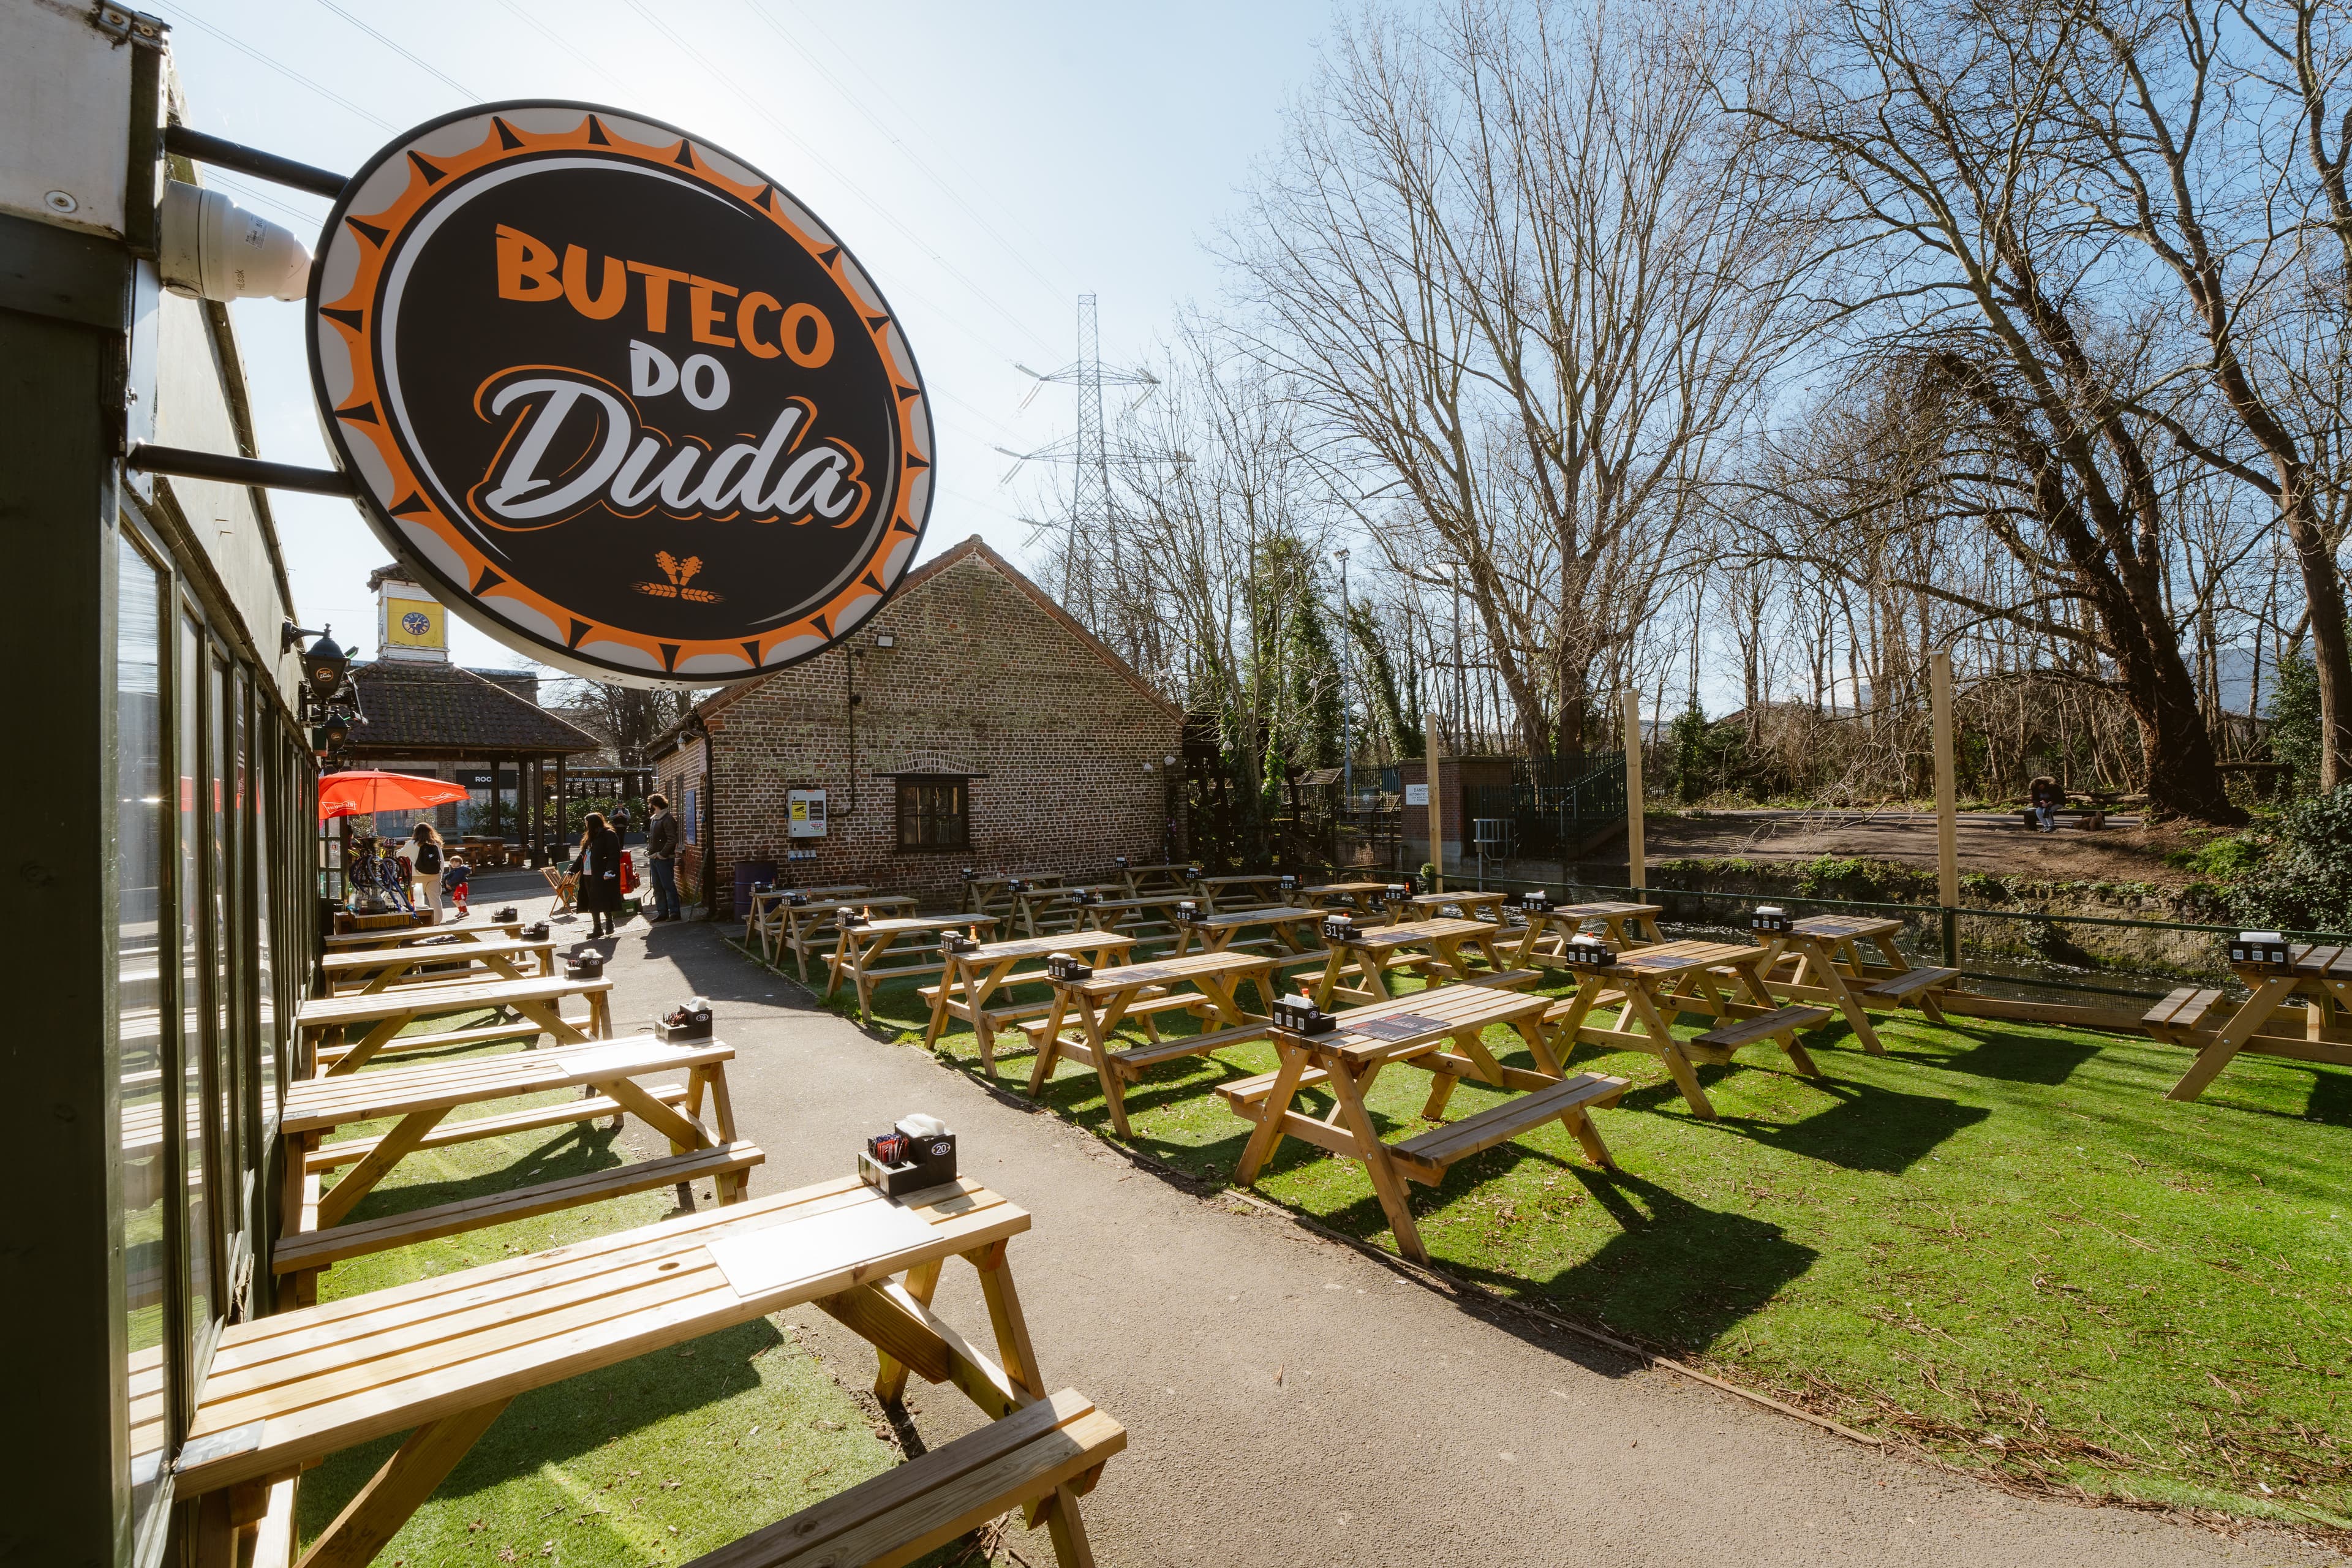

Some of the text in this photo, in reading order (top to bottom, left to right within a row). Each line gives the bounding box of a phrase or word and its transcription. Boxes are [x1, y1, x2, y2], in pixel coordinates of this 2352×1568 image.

[496, 224, 835, 369] BUTECO
[629, 339, 730, 411] DO
[485, 379, 856, 519] Duda
[1325, 924, 1338, 937] 31
[935, 1144, 947, 1154] 20
